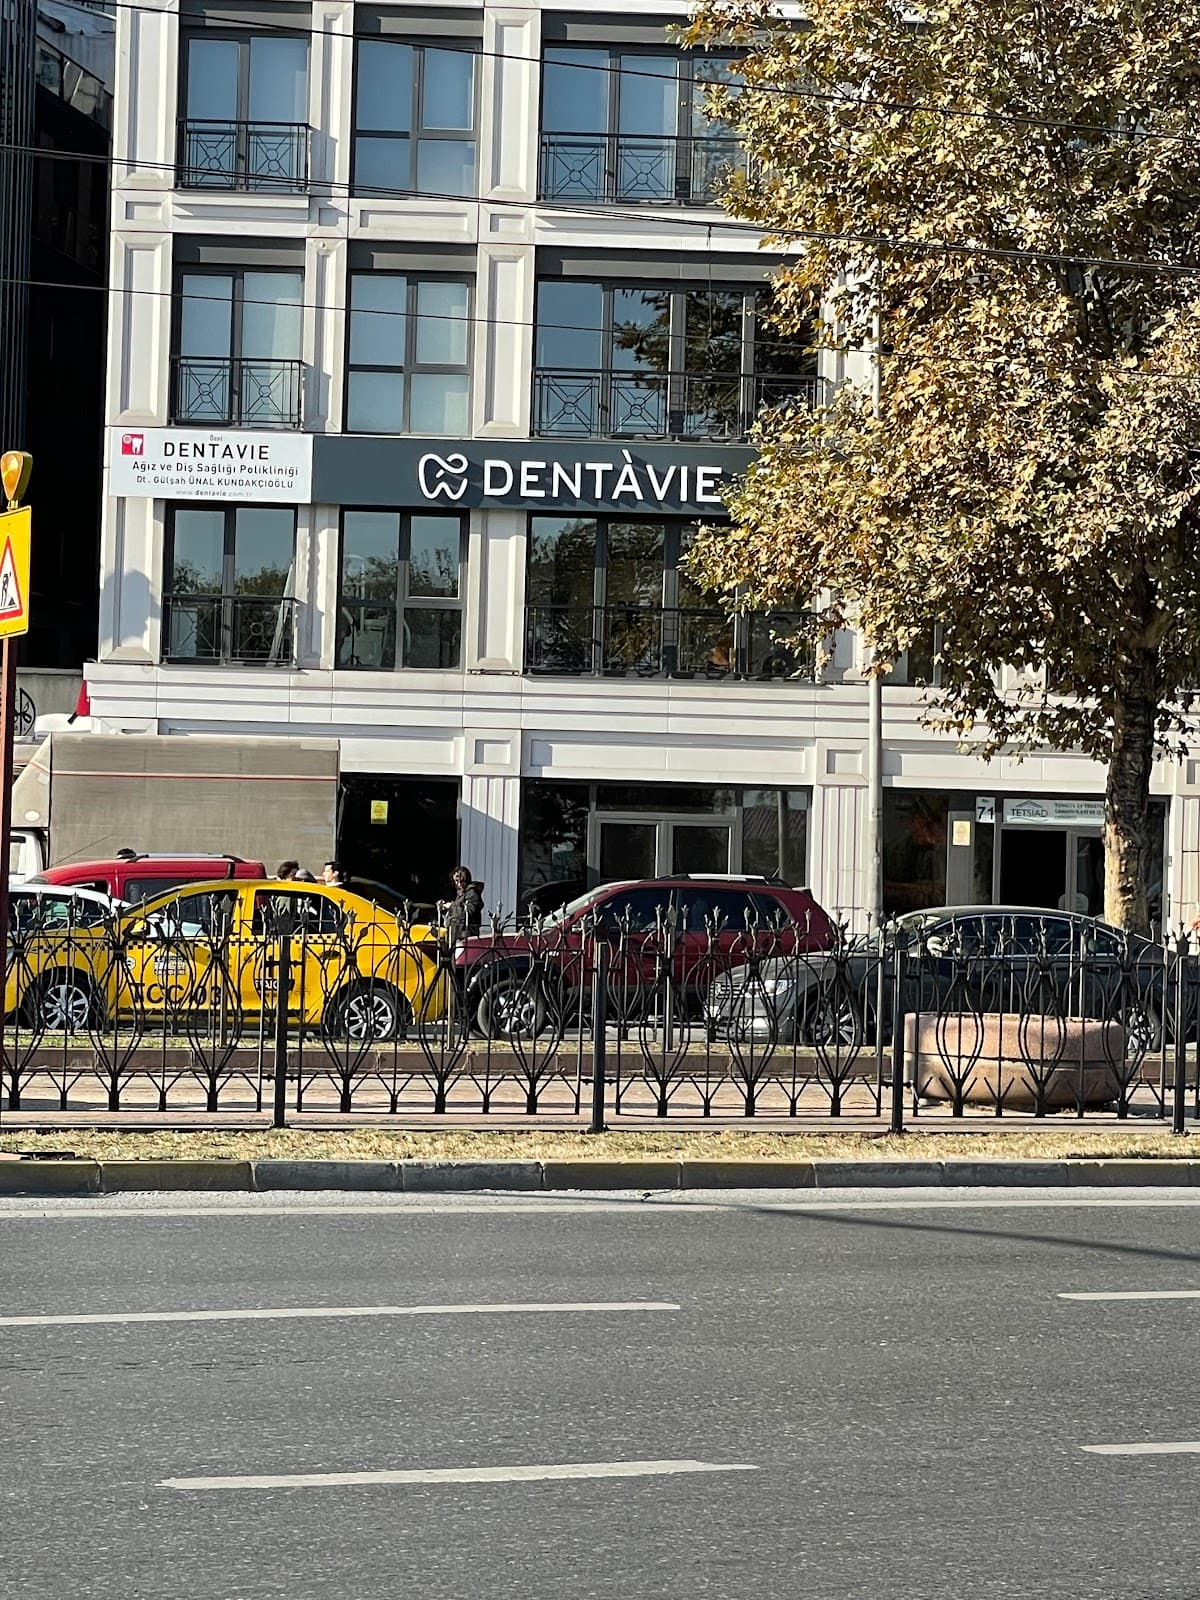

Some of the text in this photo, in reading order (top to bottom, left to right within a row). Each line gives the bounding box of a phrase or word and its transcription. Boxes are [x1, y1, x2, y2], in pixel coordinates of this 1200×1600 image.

[163, 441, 269, 460] DENTAVIE
[132, 460, 298, 477] Ağız ve Diş Sağlığı Polikliniği
[482, 449, 723, 503] DENTÀVIE
[136, 475, 151, 484] Dt.
[153, 475, 186, 486] Gülşah
[188, 475, 215, 486] ÜNAL
[977, 806, 994, 820] 71
